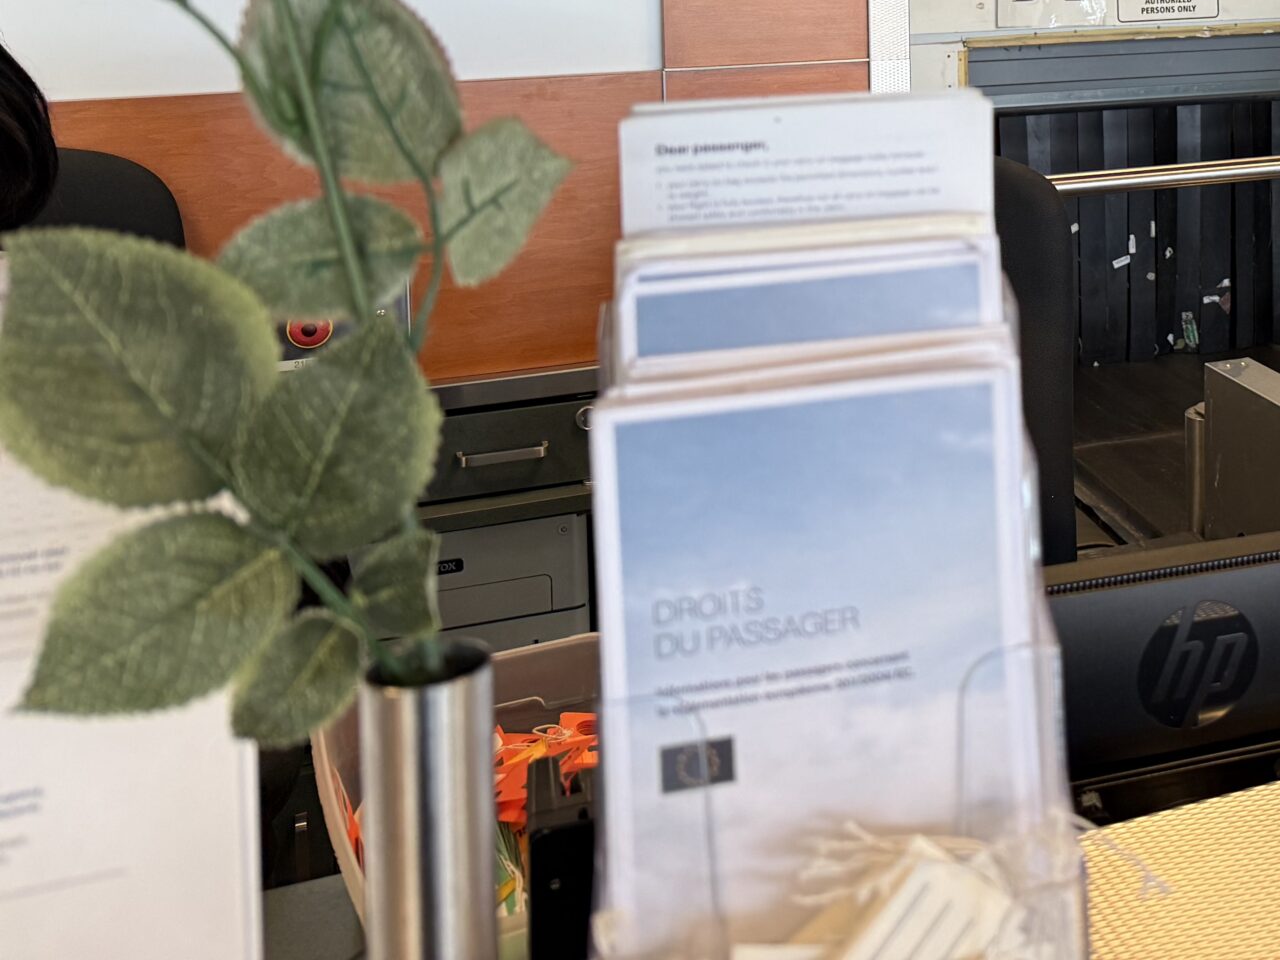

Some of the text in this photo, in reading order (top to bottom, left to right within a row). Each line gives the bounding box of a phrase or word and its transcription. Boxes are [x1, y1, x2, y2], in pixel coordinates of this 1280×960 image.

[1141, 5, 1197, 15] PERSONS ONLY
[653, 587, 765, 626] DROITS
[654, 605, 861, 660] DU PASSAGER
[1150, 602, 1249, 729] hp
